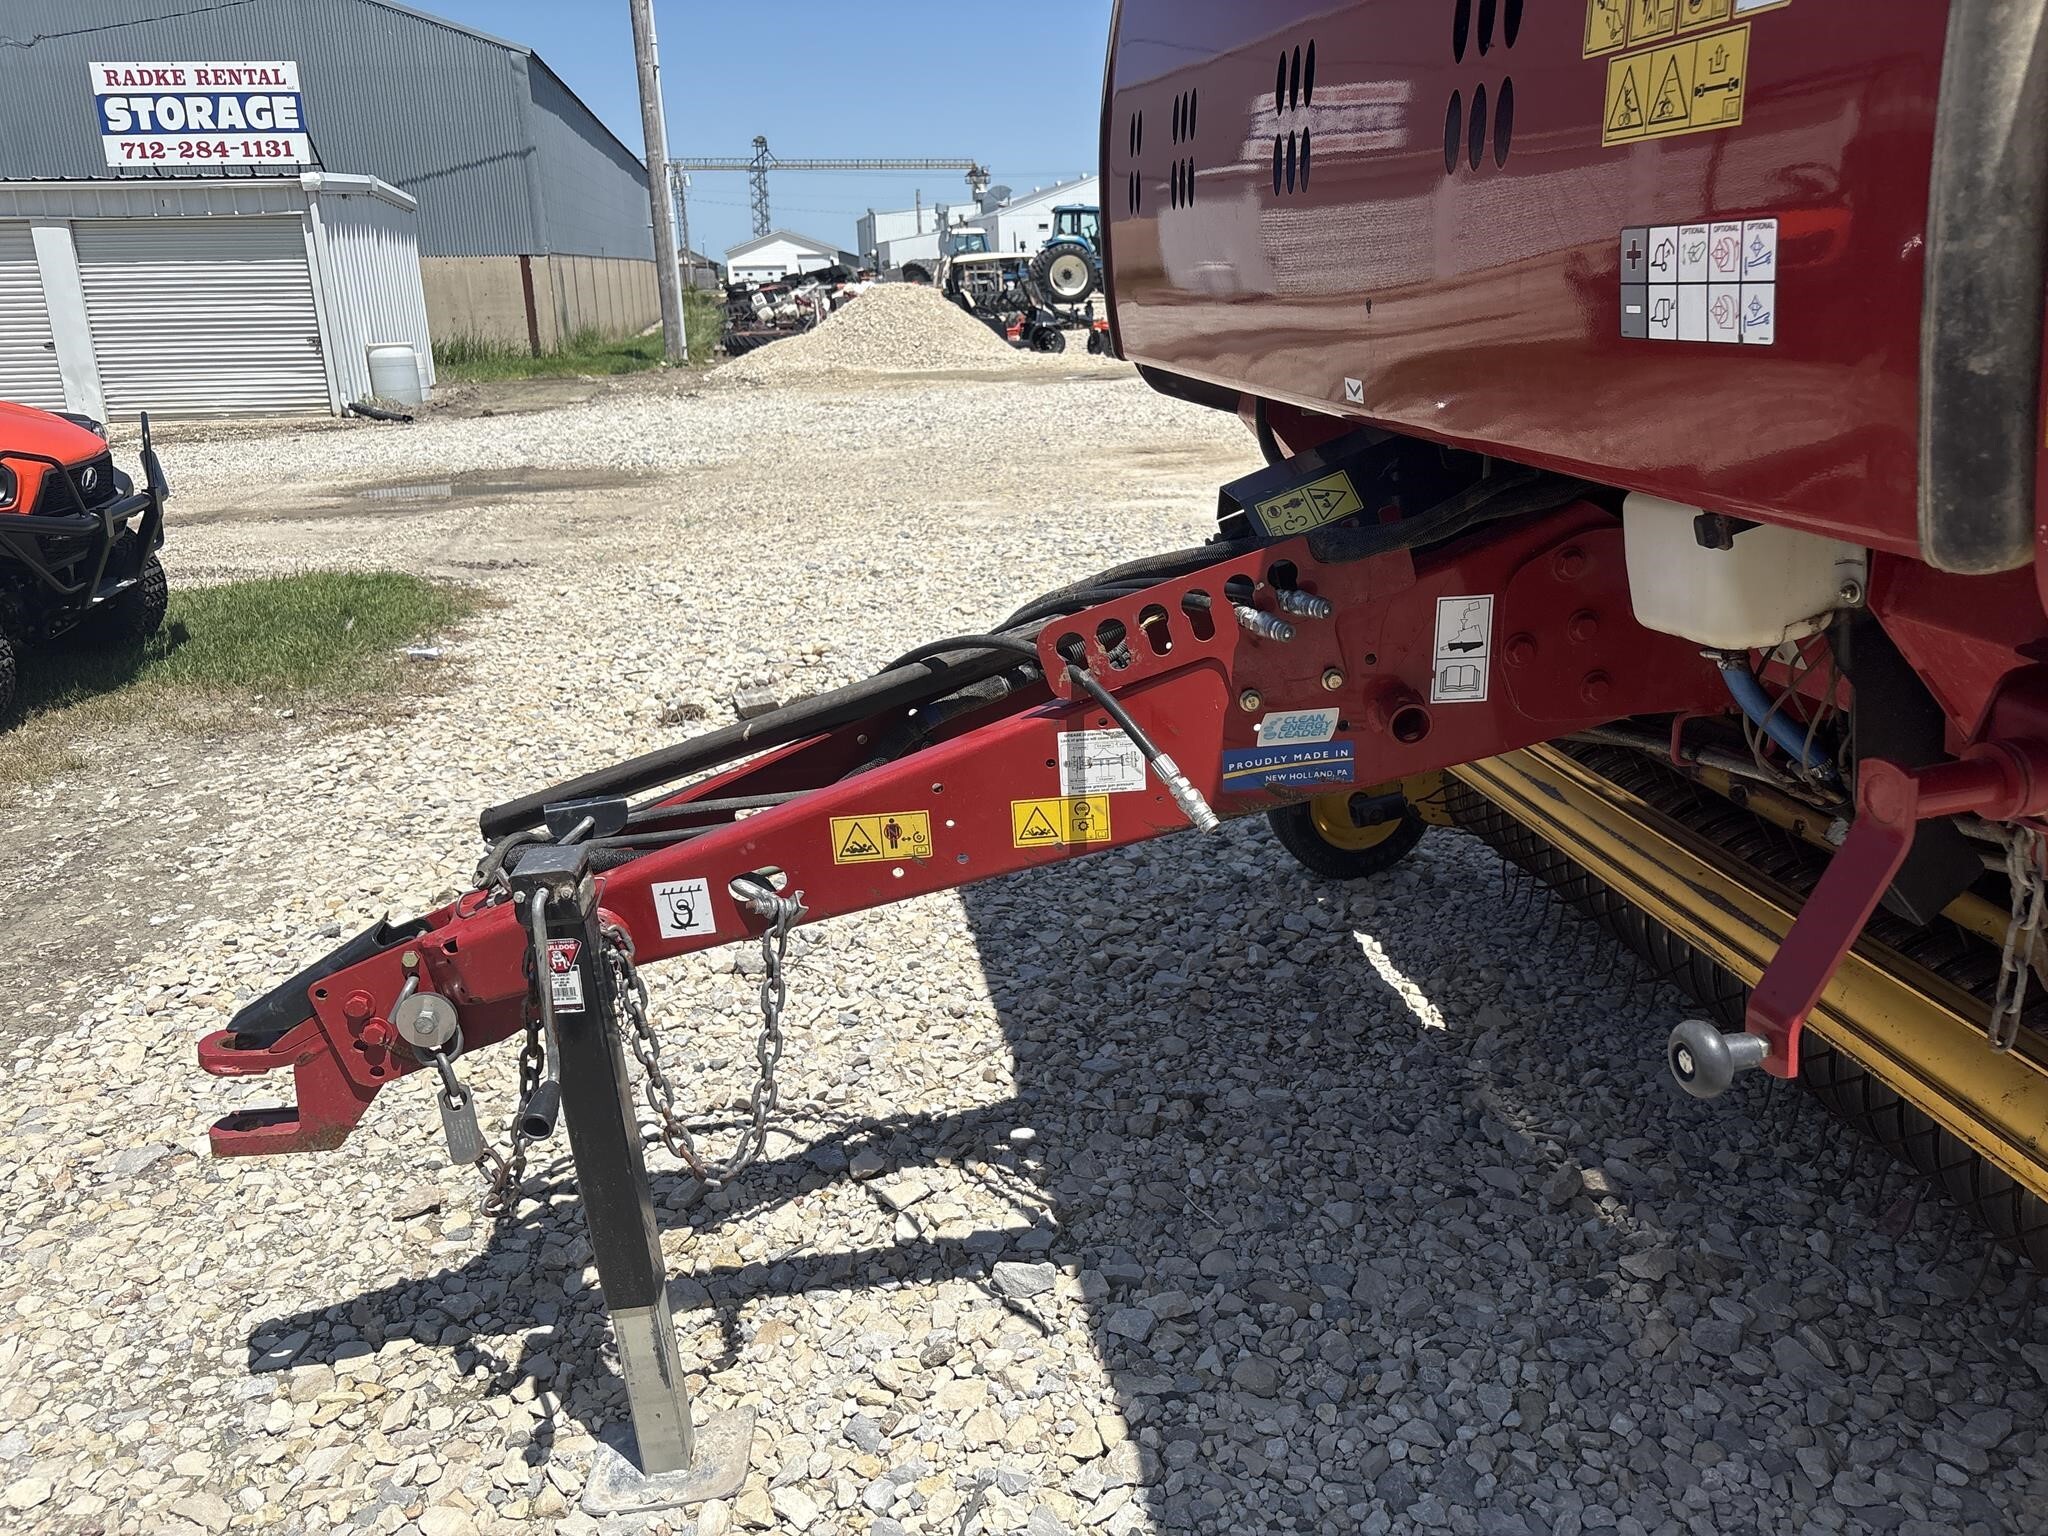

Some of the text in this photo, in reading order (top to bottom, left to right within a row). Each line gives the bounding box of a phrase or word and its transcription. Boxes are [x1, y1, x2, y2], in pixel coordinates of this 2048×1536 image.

[103, 68, 287, 87] RADKE RENTAL
[104, 95, 300, 132] STORAGE
[120, 139, 295, 160] 712-284-1131
[1681, 227, 1706, 235] OPTIONAL
[1713, 224, 1740, 233] OPTIONAL
[1746, 222, 1775, 231] OPTIONAL
[1284, 713, 1326, 724] CLEAN
[1280, 719, 1333, 732] ENERGY
[1277, 728, 1328, 739] LEADER
[1228, 749, 1349, 772] PROUDLY MADE IN
[1265, 768, 1348, 782] NEW HOLLAND, PA
